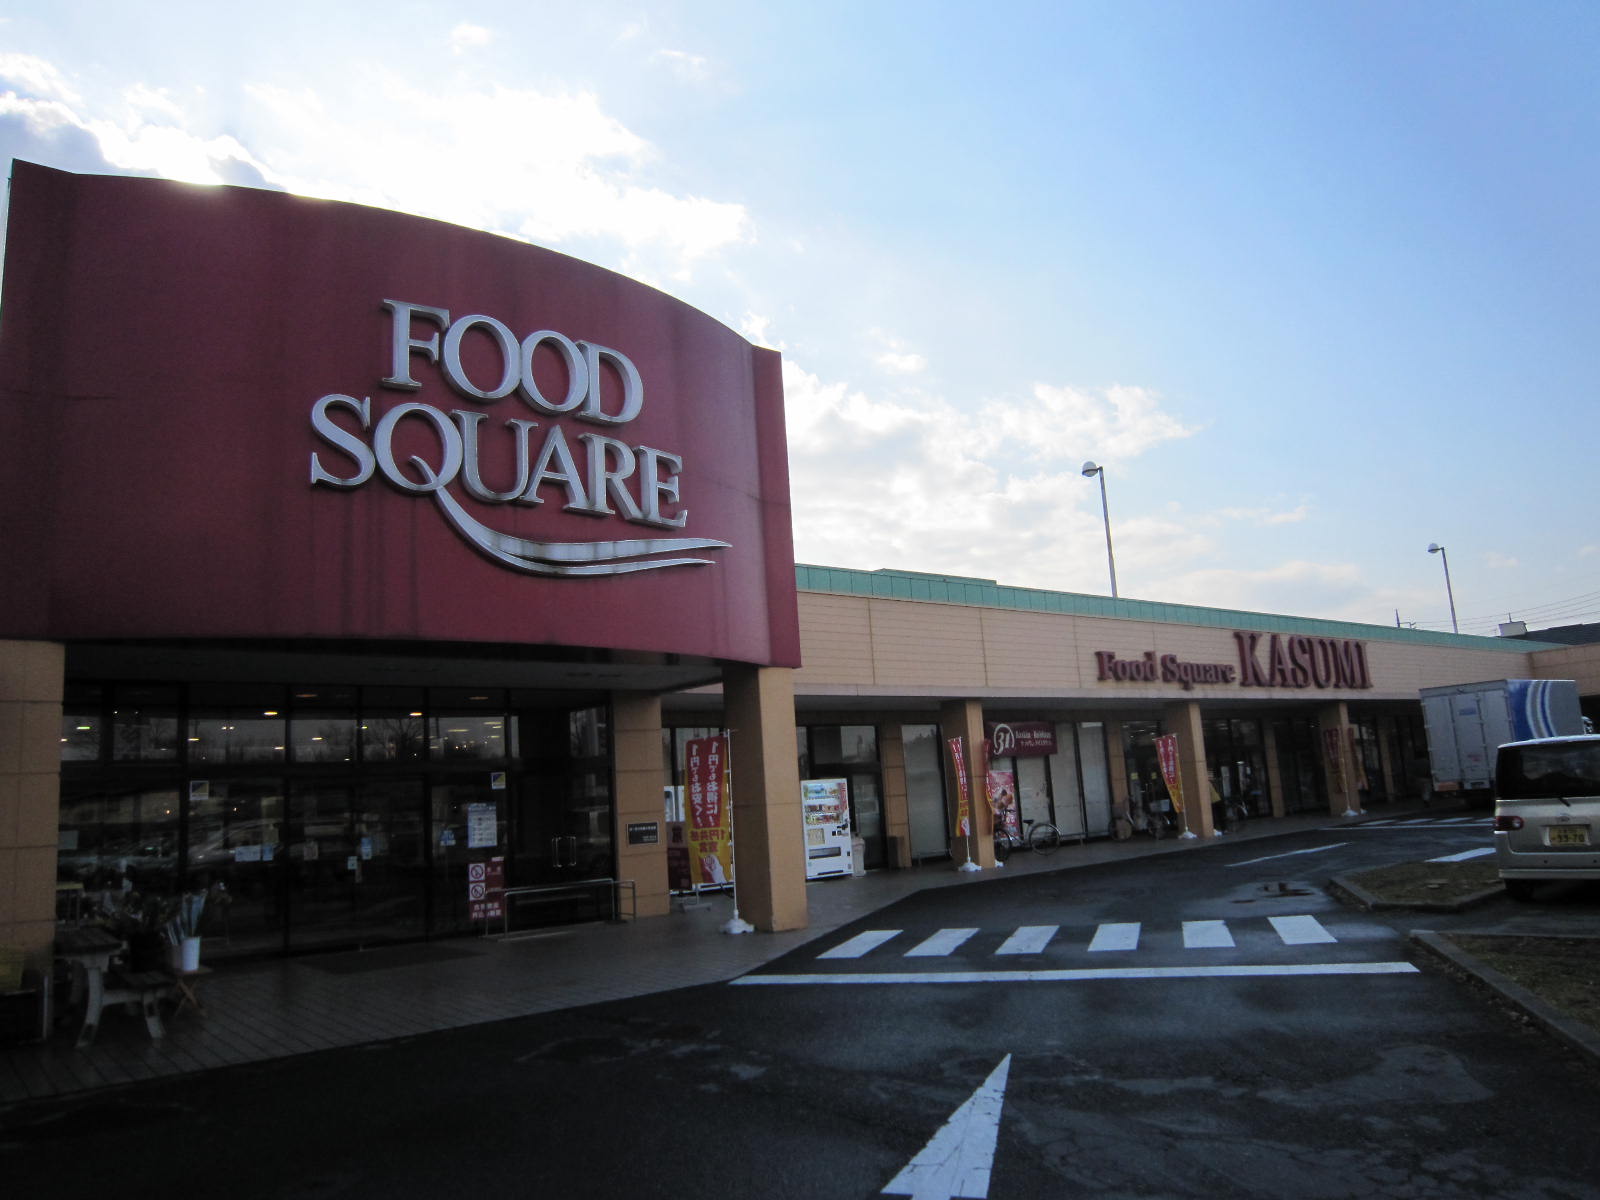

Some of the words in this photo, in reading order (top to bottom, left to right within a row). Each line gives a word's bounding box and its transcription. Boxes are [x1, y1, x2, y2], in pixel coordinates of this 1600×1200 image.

[382, 298, 645, 425] FOOD
[310, 393, 689, 530] SQUARE
[1095, 651, 1159, 682] Food
[1161, 654, 1236, 690] Square
[1234, 631, 1373, 689] KASUMI
